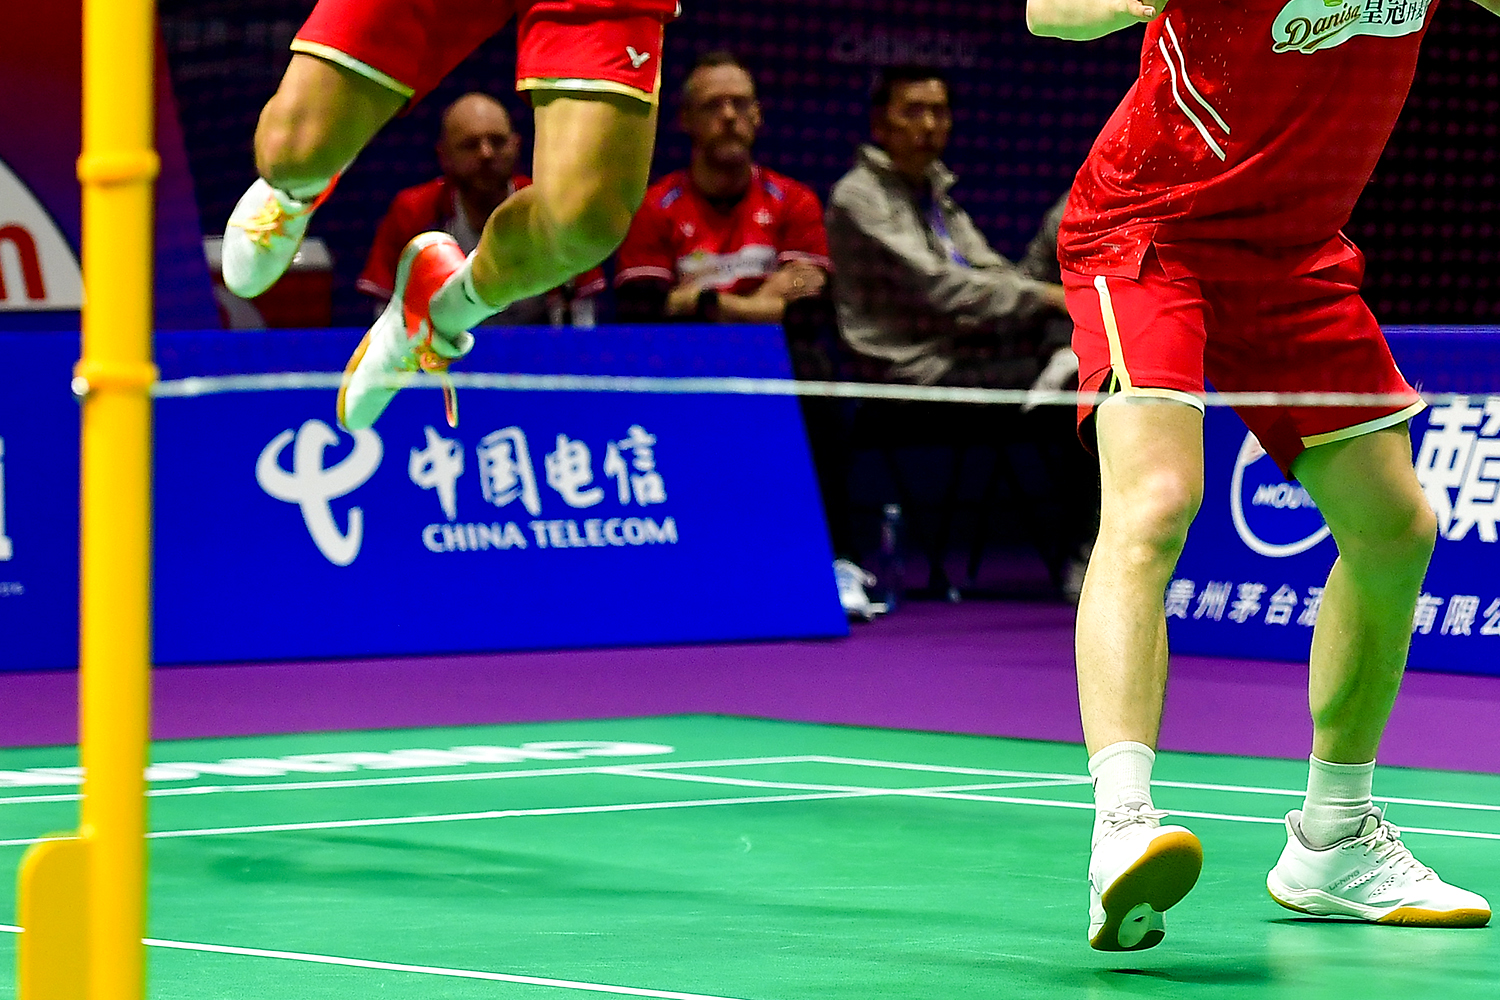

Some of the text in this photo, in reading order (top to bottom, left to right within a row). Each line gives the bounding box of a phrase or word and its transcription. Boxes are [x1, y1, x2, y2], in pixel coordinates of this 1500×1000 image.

[1274, 3, 1362, 50] Danisa
[408, 424, 668, 520] 中国电信
[422, 516, 678, 553] CHINA TELECOM
